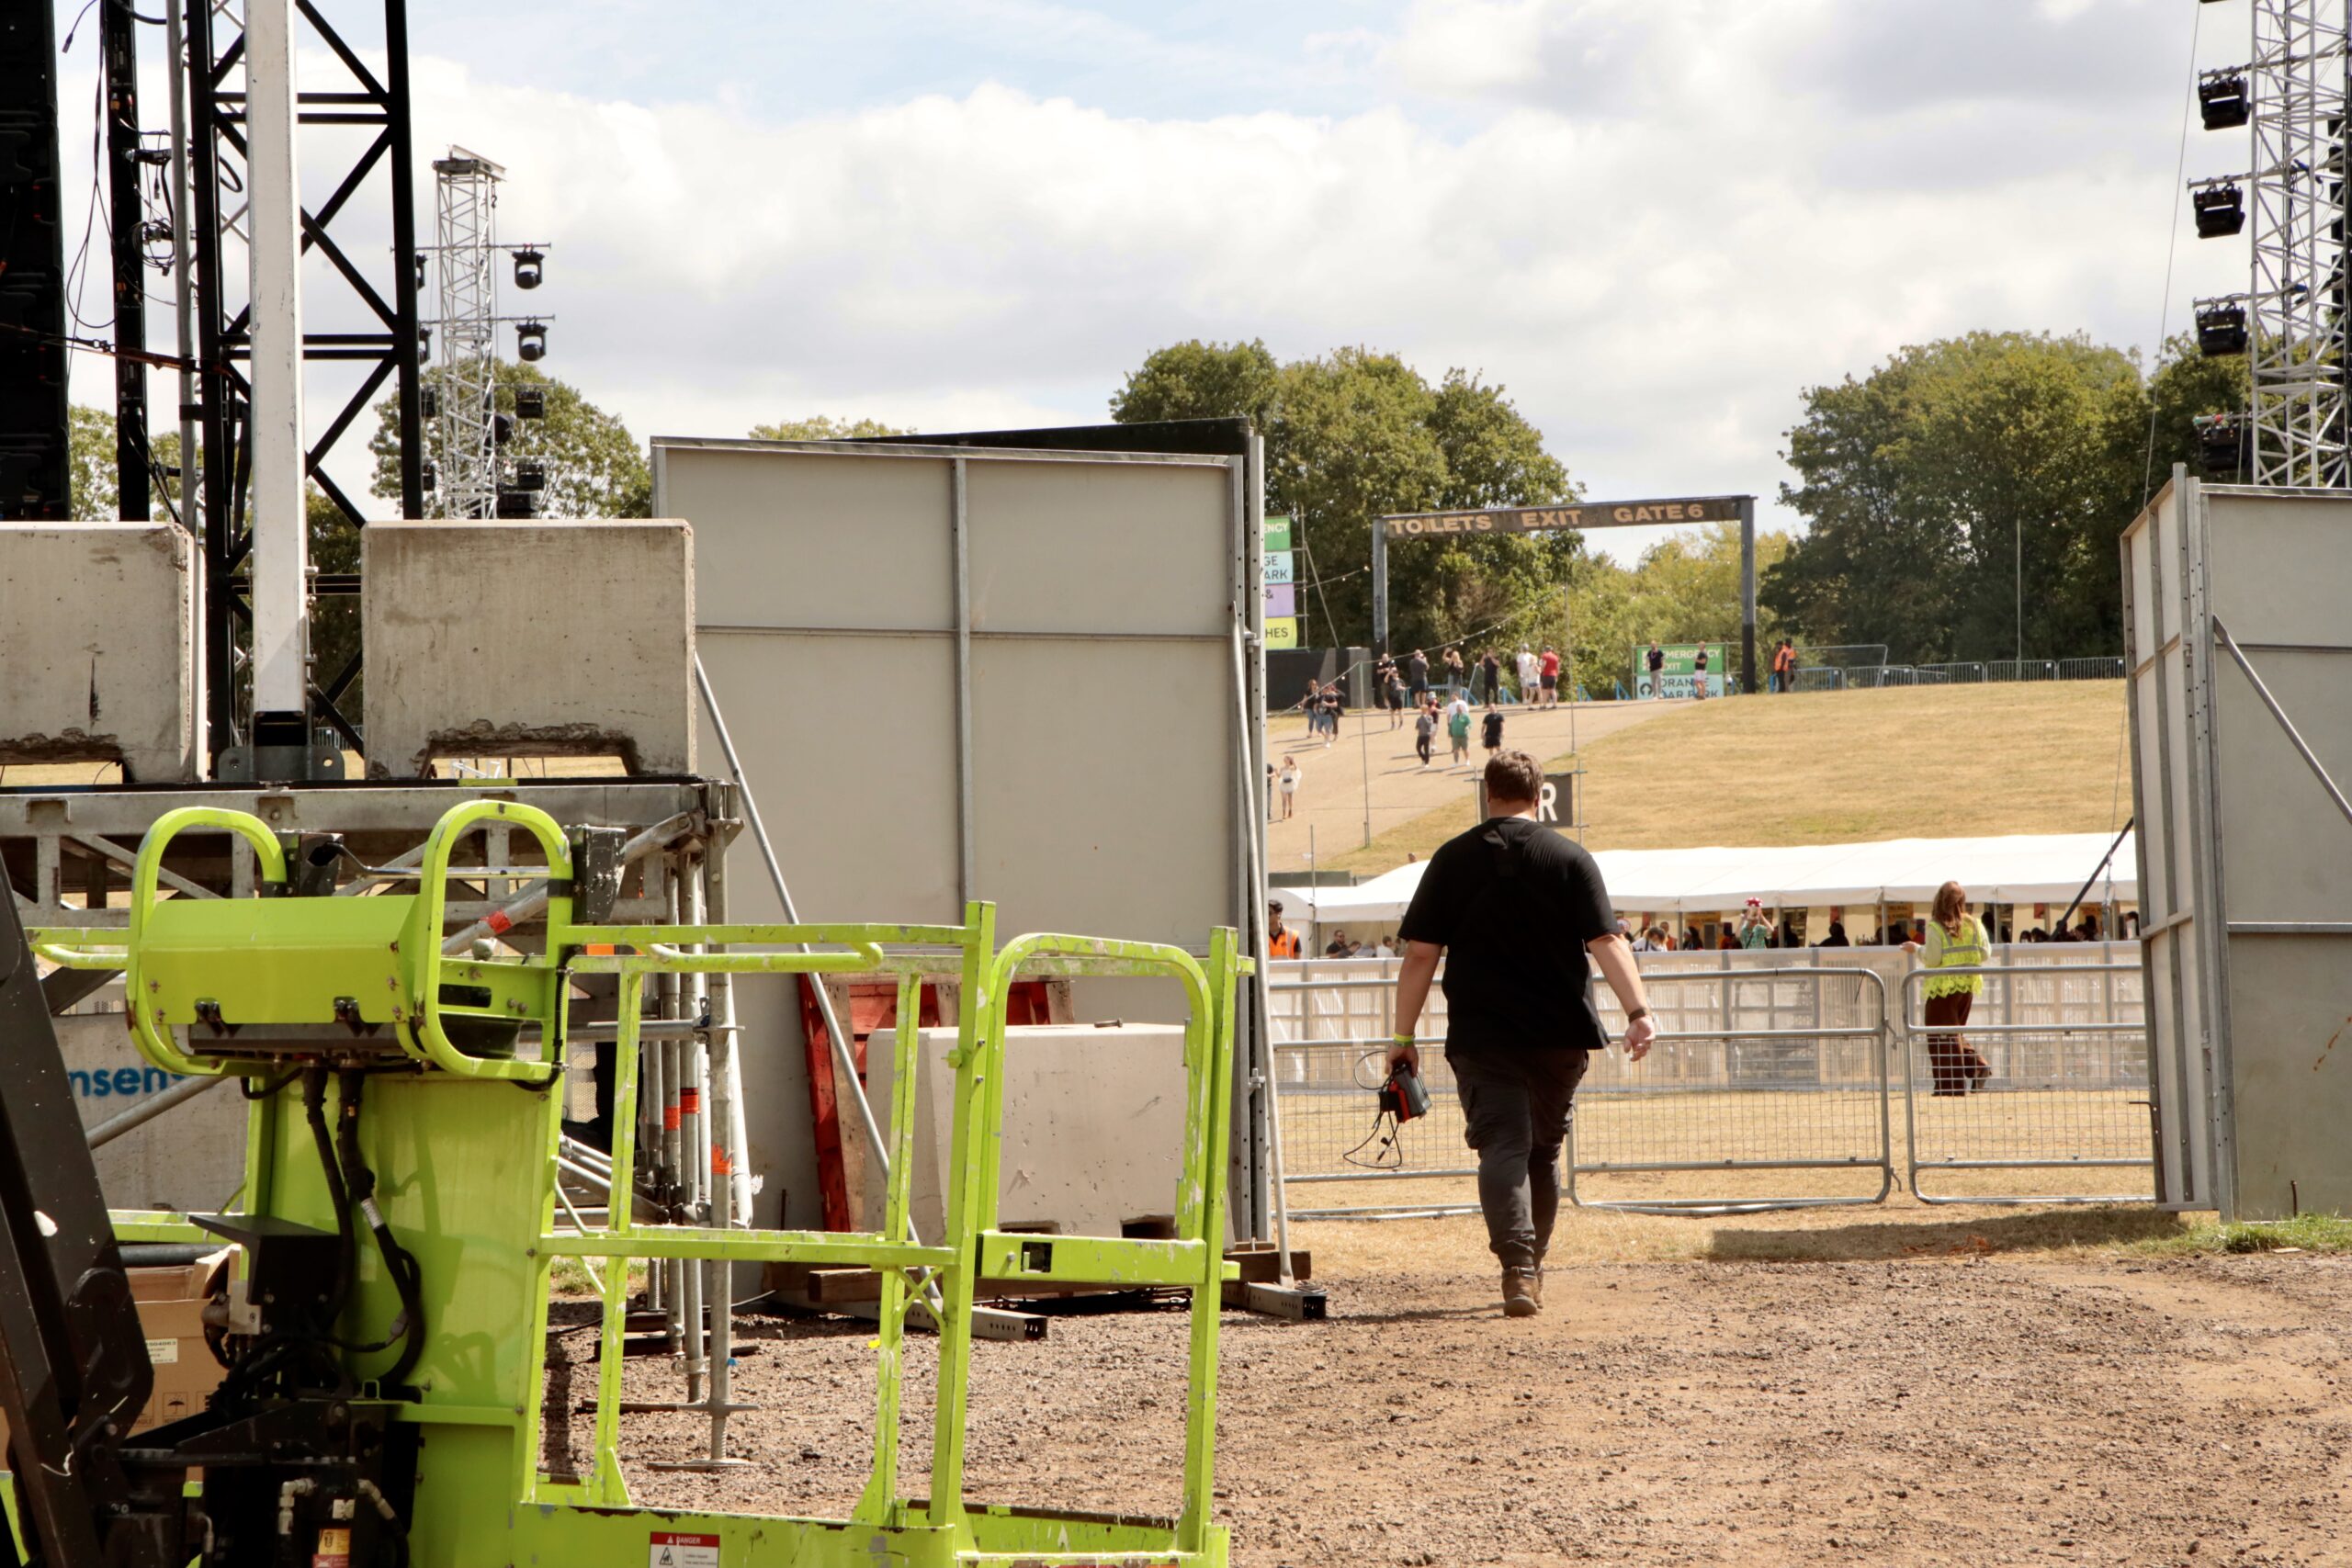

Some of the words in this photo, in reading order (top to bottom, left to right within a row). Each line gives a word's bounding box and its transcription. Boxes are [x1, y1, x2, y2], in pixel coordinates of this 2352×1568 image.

[1389, 515, 1492, 535] TOILETS
[1521, 510, 1581, 527] EXIT
[1613, 504, 1684, 523] GATE
[1688, 503, 1704, 518] 6
[1265, 627, 1288, 637] HES
[1537, 782, 1558, 822] R
[68, 1067, 186, 1097] nsen
[676, 1536, 701, 1544] DANGER
